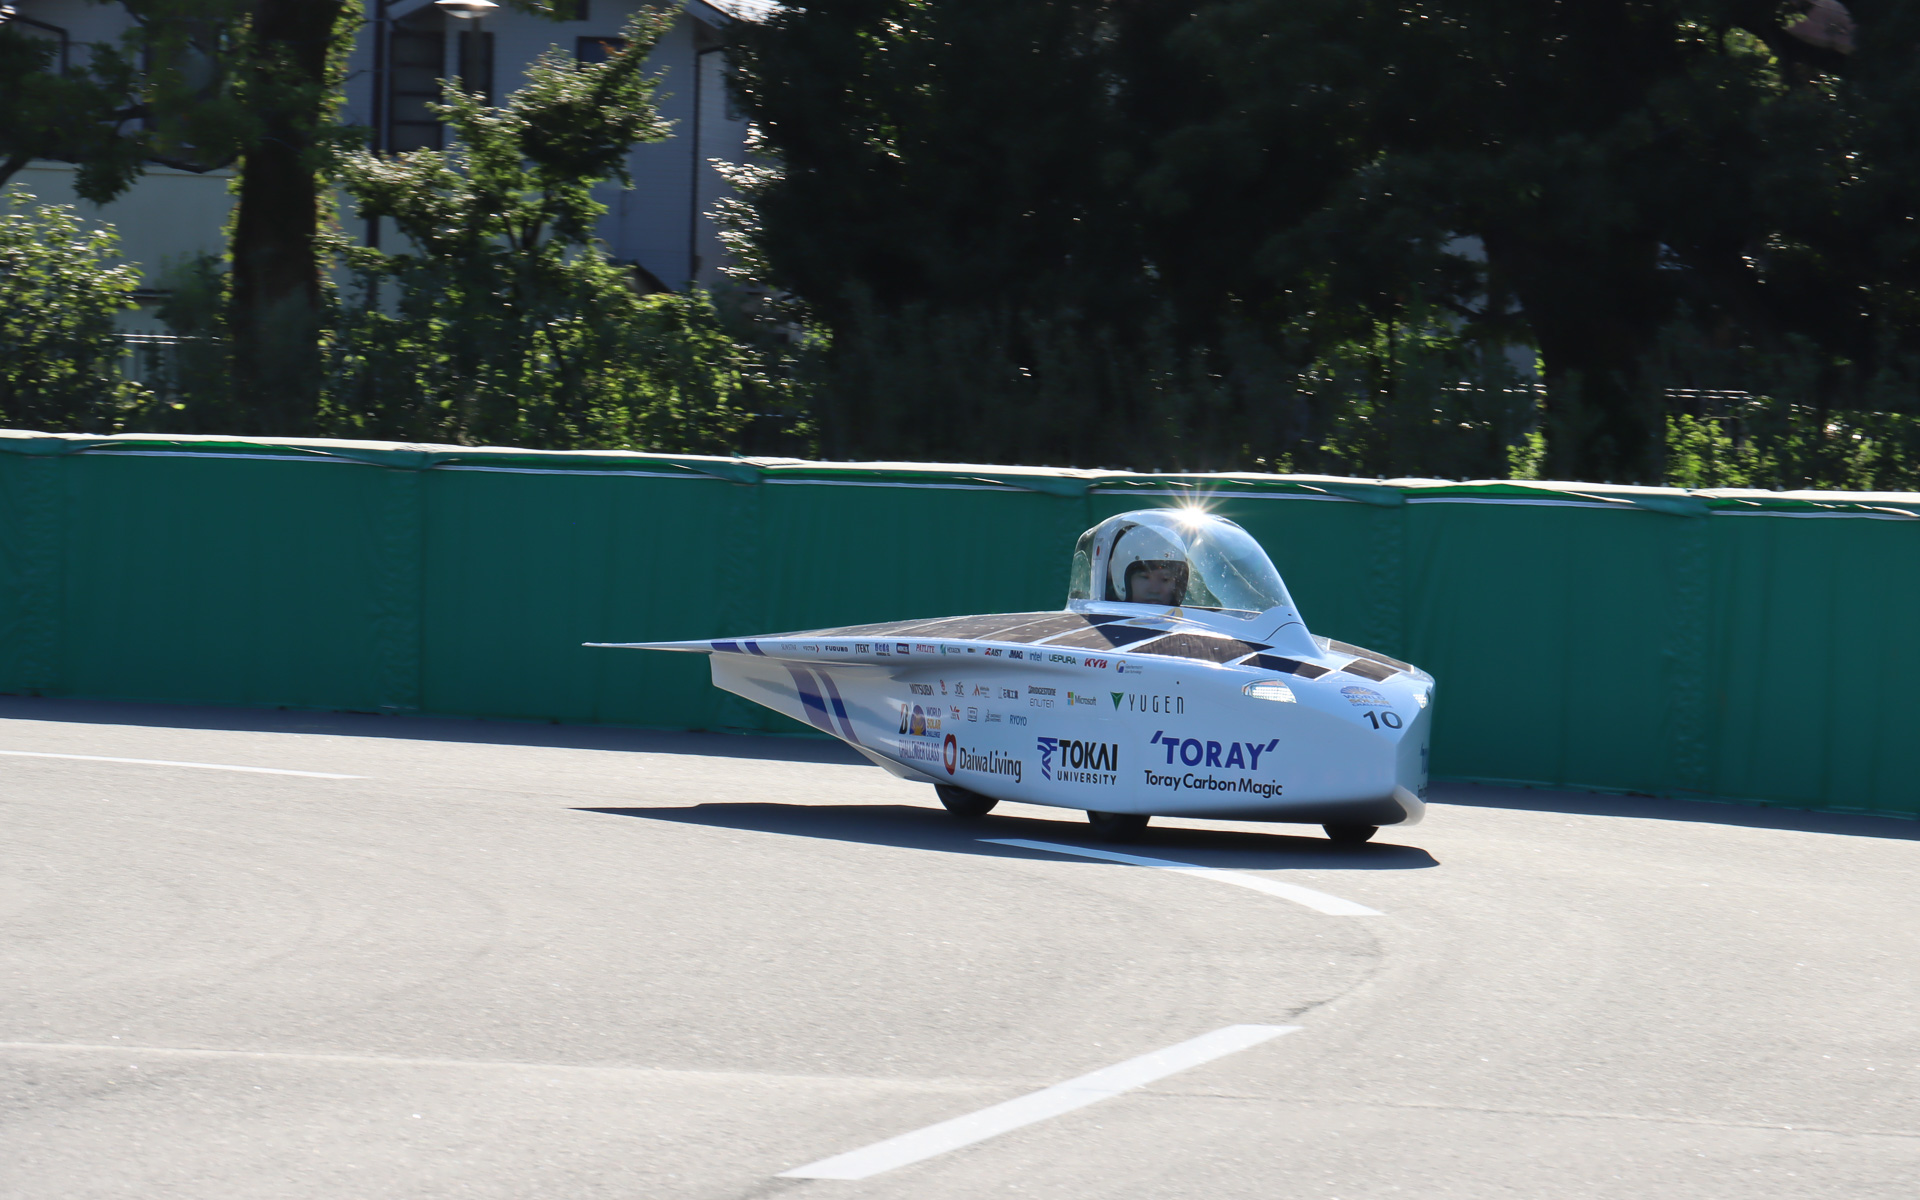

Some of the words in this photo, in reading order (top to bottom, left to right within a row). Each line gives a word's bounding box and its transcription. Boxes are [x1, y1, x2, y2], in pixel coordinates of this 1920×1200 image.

[916, 643, 935, 653] PATLITE
[991, 648, 1003, 656] AIST
[1008, 650, 1023, 659] JMAG
[1048, 654, 1076, 665] UEPURA
[1084, 657, 1108, 669] KYB
[909, 683, 934, 696] MITSUBA
[1074, 694, 1097, 706] Microsoft
[1128, 693, 1184, 714] YUGEN
[926, 707, 942, 718] WORLD
[926, 719, 941, 730] SOLAR
[1009, 714, 1027, 726] RYOYO
[1363, 710, 1403, 730] 10
[1058, 739, 1118, 772] TOKAI
[960, 747, 988, 773] Daiwa
[989, 749, 1022, 784] Living
[1057, 770, 1117, 786] UNIVERSITY
[1144, 769, 1182, 791] Toray
[1183, 772, 1237, 792] Carbon
[1238, 777, 1284, 799] Magic
